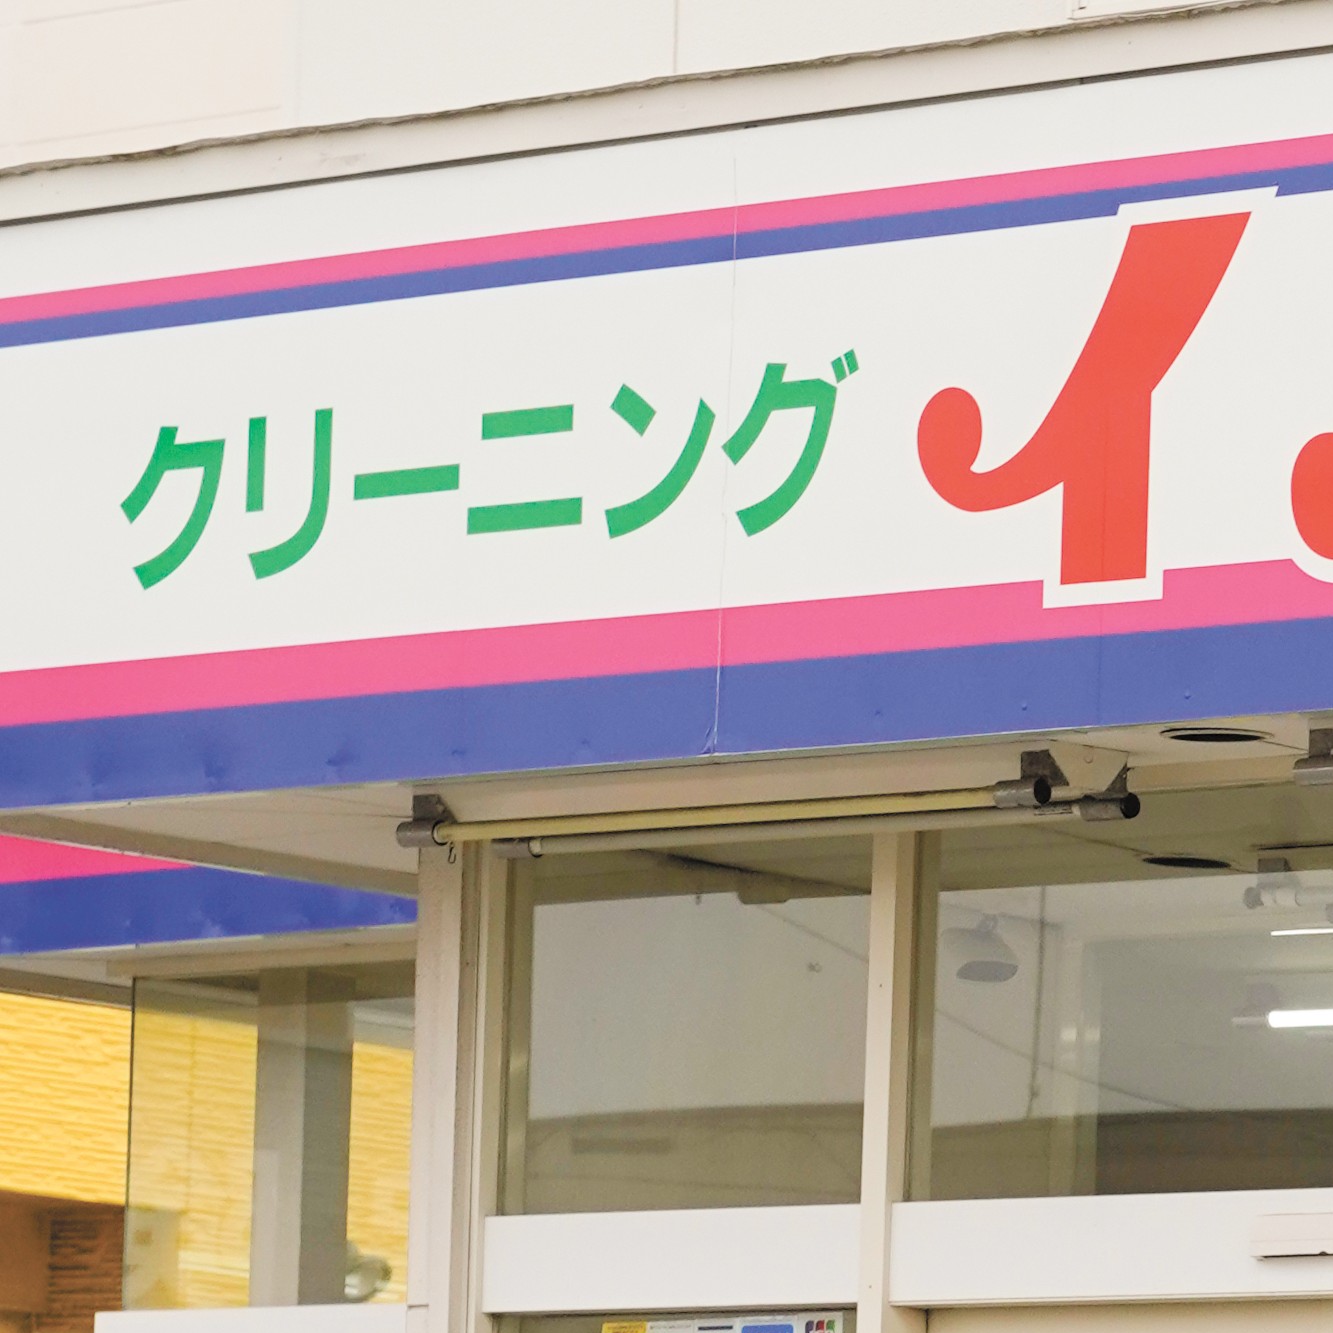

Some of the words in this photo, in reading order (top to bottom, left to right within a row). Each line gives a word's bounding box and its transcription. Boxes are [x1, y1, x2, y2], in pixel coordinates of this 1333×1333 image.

[120, 350, 862, 590] クリーニング
